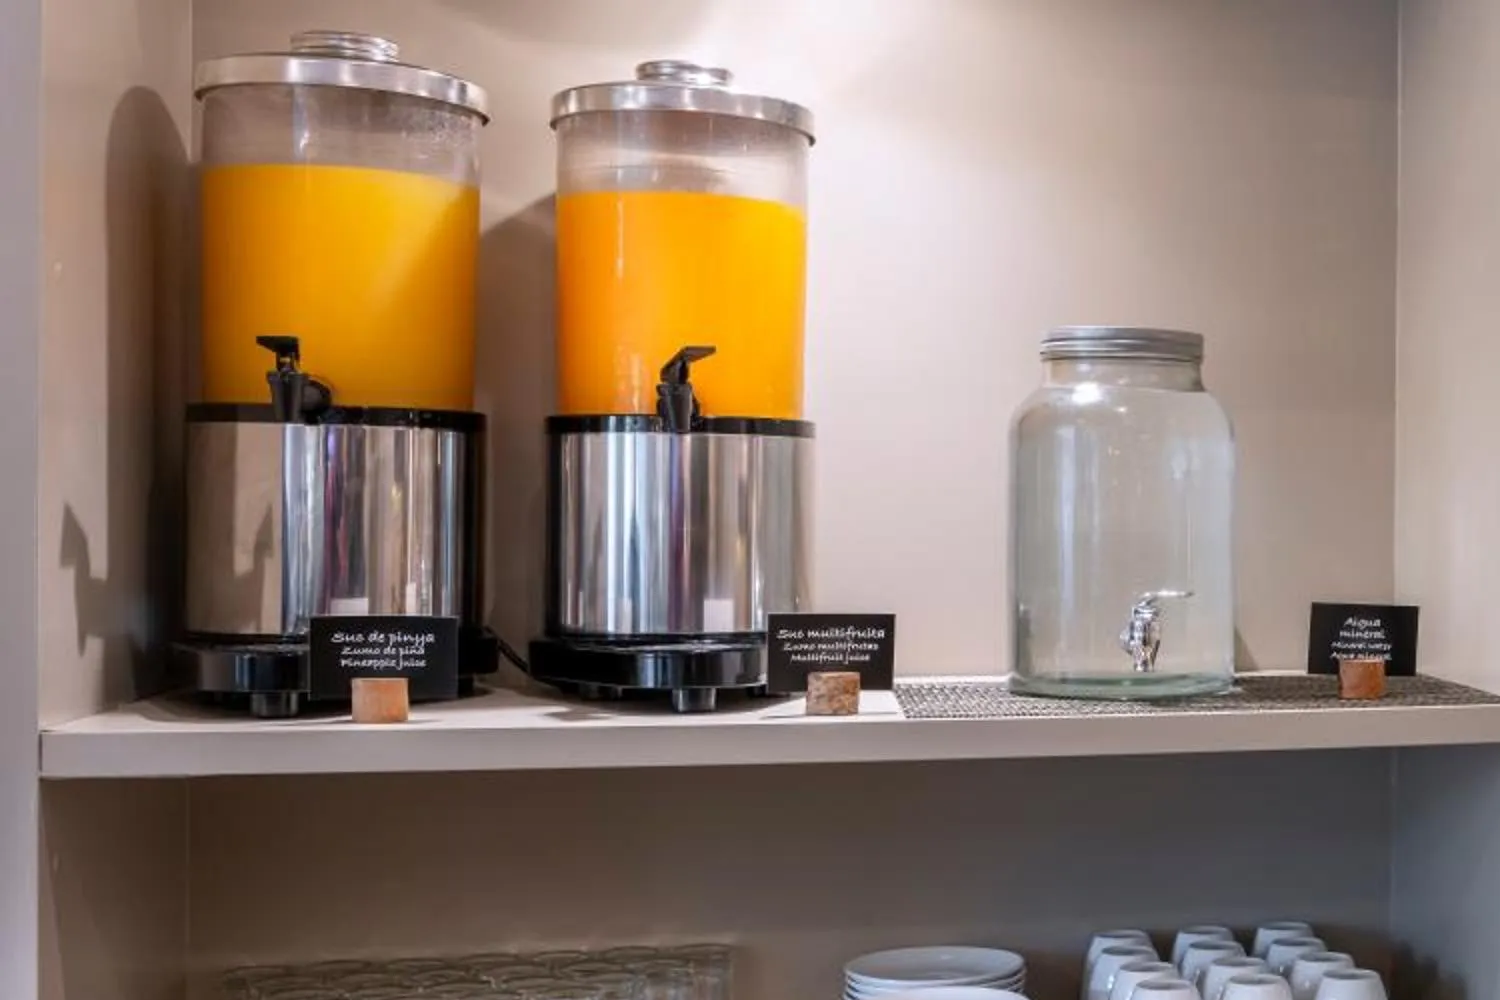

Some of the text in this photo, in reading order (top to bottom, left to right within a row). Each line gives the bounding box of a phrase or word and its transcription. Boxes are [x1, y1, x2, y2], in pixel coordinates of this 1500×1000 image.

[1343, 616, 1381, 630] Aigua
[368, 630, 385, 643] de
[388, 631, 435, 647] pinya
[807, 626, 885, 640] multifruita
[1340, 628, 1386, 639] mineral
[341, 645, 425, 657] Zumo de piña
[340, 658, 426, 671] Pineapple juice
